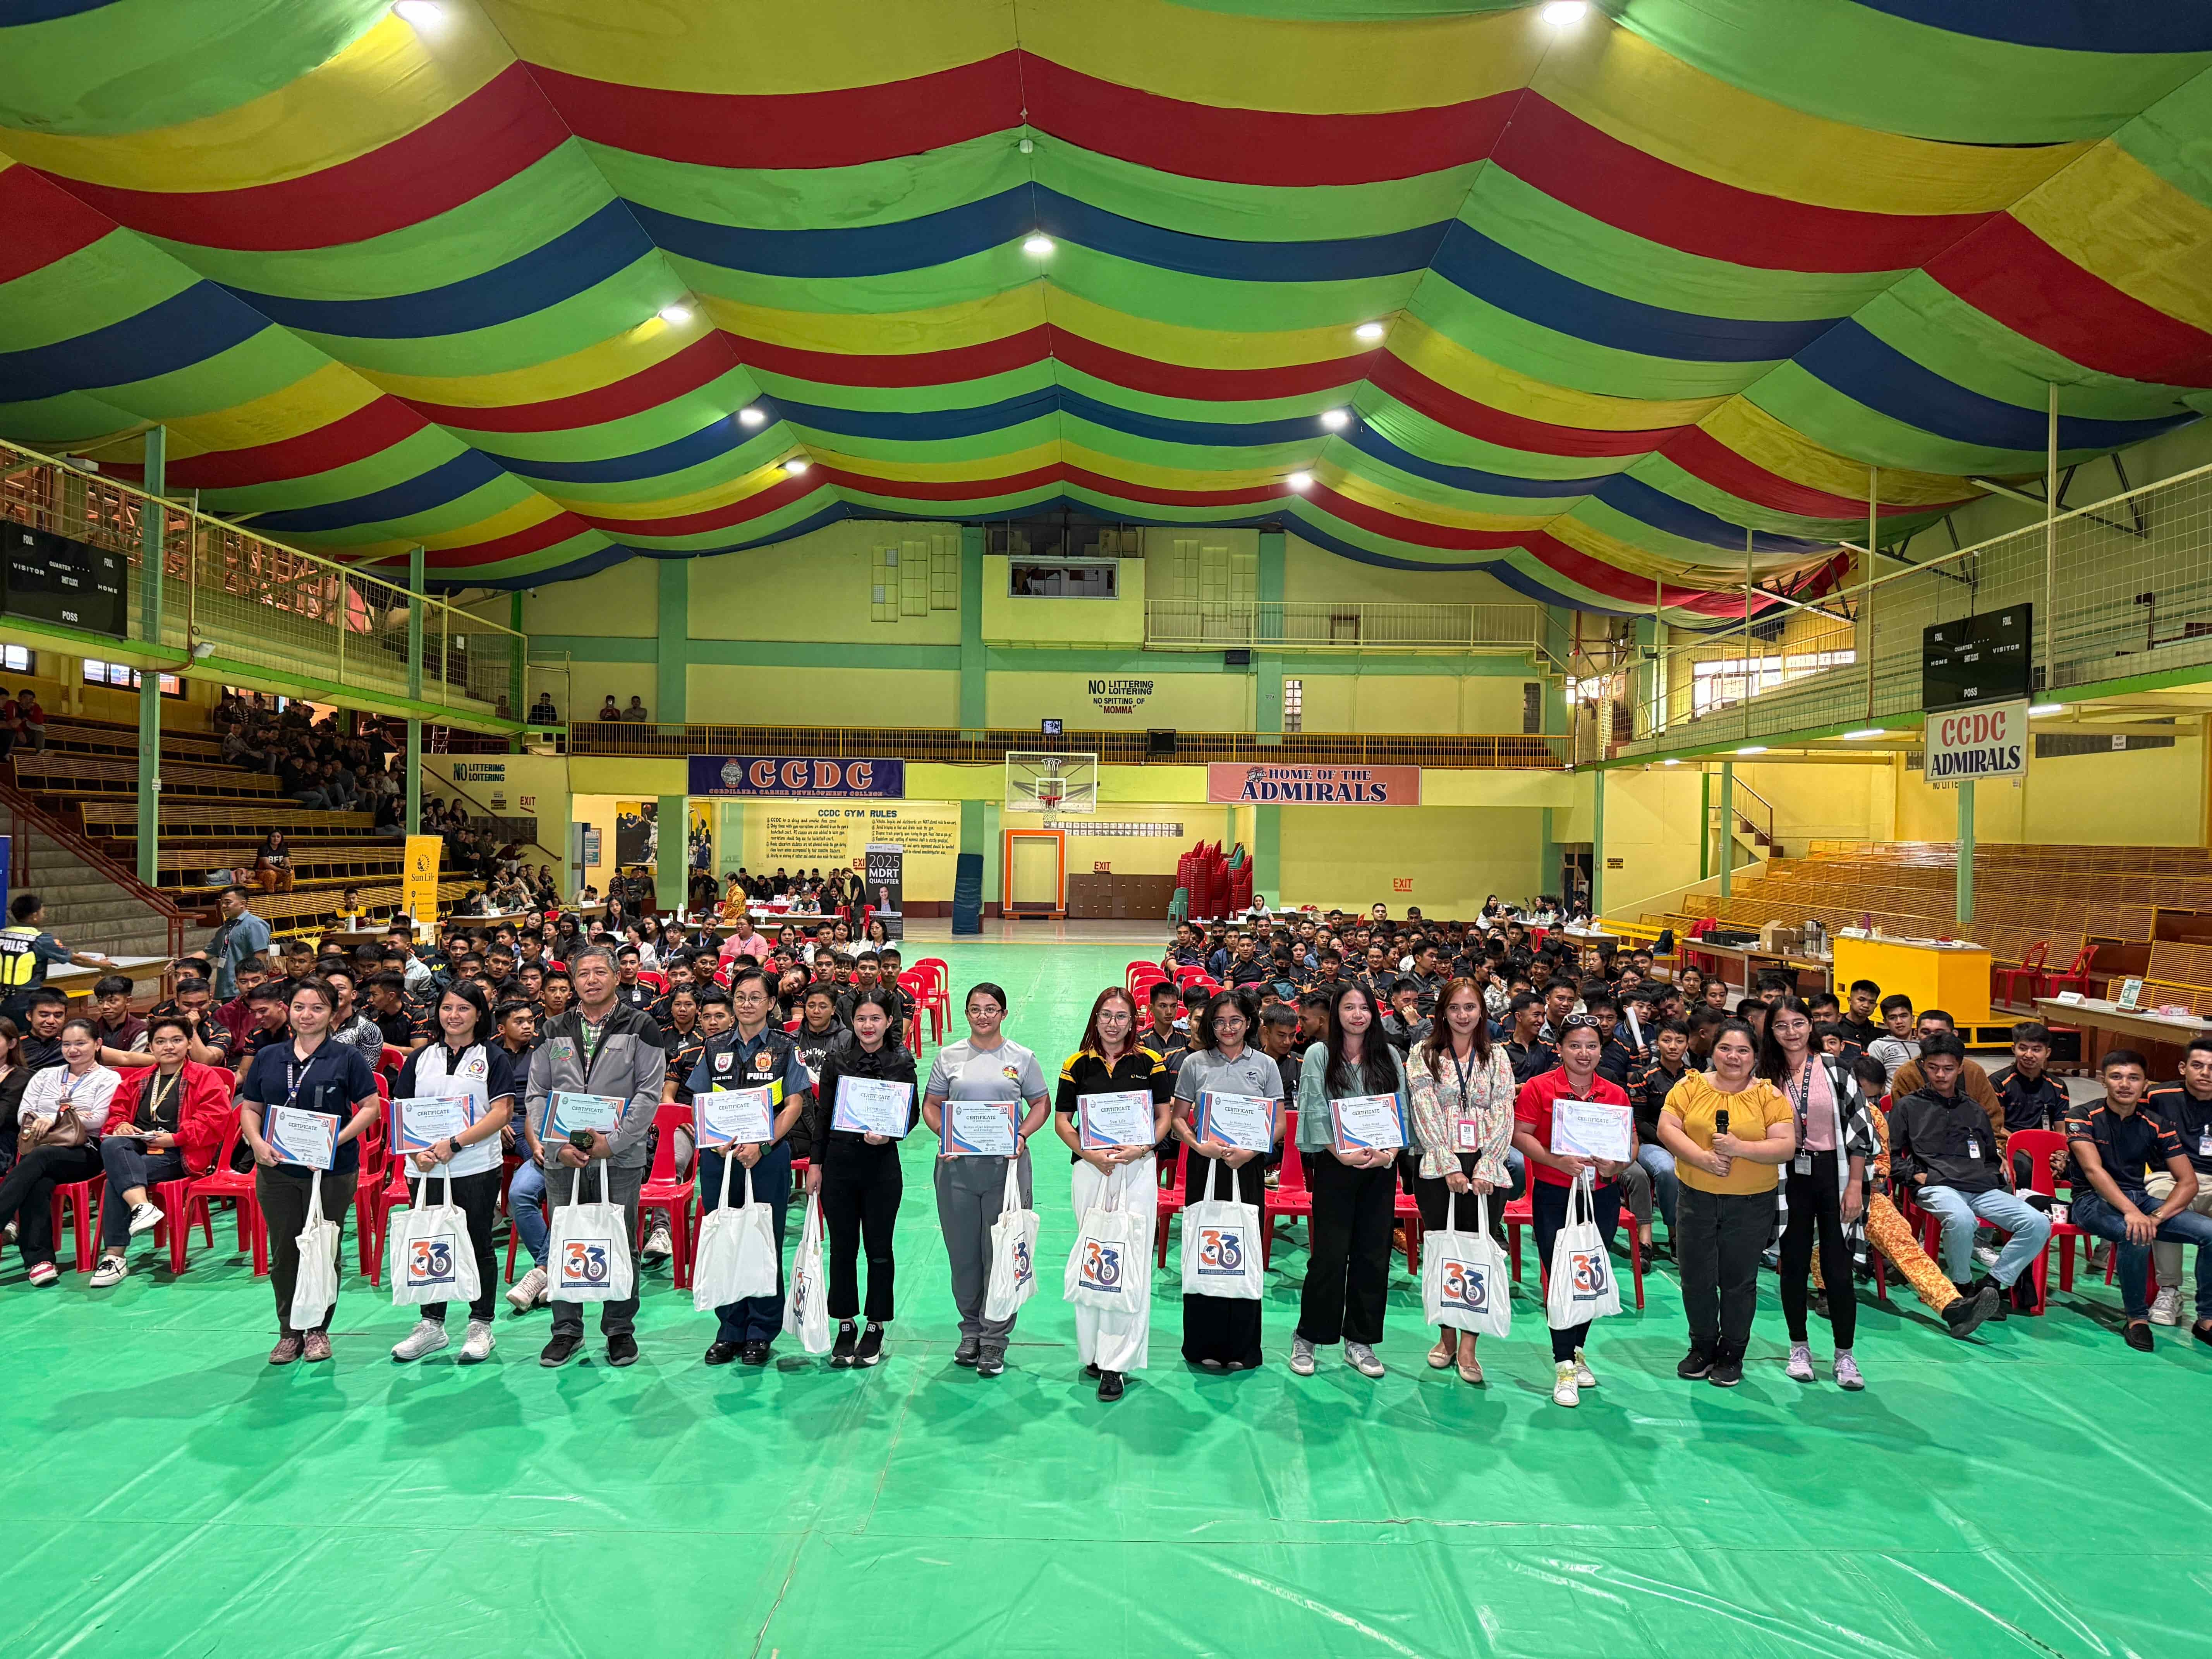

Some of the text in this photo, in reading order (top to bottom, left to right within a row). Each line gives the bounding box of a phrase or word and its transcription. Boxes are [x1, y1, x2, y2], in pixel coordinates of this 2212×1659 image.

[23, 534, 34, 546] FOUL
[13, 562, 45, 576] VISITOR
[49, 561, 71, 572] QUARTER
[98, 584, 118, 594] HOME
[62, 611, 78, 622] POSS
[1954, 644, 1973, 652] QUARTER
[1992, 644, 2020, 654] VISITOR
[1088, 680, 1154, 695] NO LITTERING
[1964, 687, 1977, 698] POSS
[1941, 710, 2006, 747] CCDC
[1931, 745, 2021, 777] ADMIRALS
[453, 763, 505, 781] NO LITTERING
[469, 772, 505, 781] LOITERING
[749, 759, 873, 790] CCDC
[1268, 768, 1372, 781] HOME OF THE
[1942, 781, 1958, 789] LITTE
[1240, 780, 1388, 803] ADMIRALS
[520, 796, 536, 806] EXIT
[853, 858, 865, 867] EXI
[869, 855, 900, 868] 2025
[1094, 861, 1111, 870] EXIT
[411, 872, 434, 881] Sun Life
[869, 868, 899, 878] MDRT
[1393, 878, 1413, 888] EXIT
[747, 1072, 774, 1080] PULIS
[1224, 1106, 1254, 1115] CERTIFICATE
[288, 1122, 318, 1131] CERTIFICATE
[1200, 1230, 1242, 1269] 33
[410, 1241, 452, 1278] 33
[563, 1243, 608, 1282] 33
[1084, 1242, 1120, 1285] 33
[1572, 1254, 1603, 1292] 33
[1443, 1262, 1486, 1306] 33
